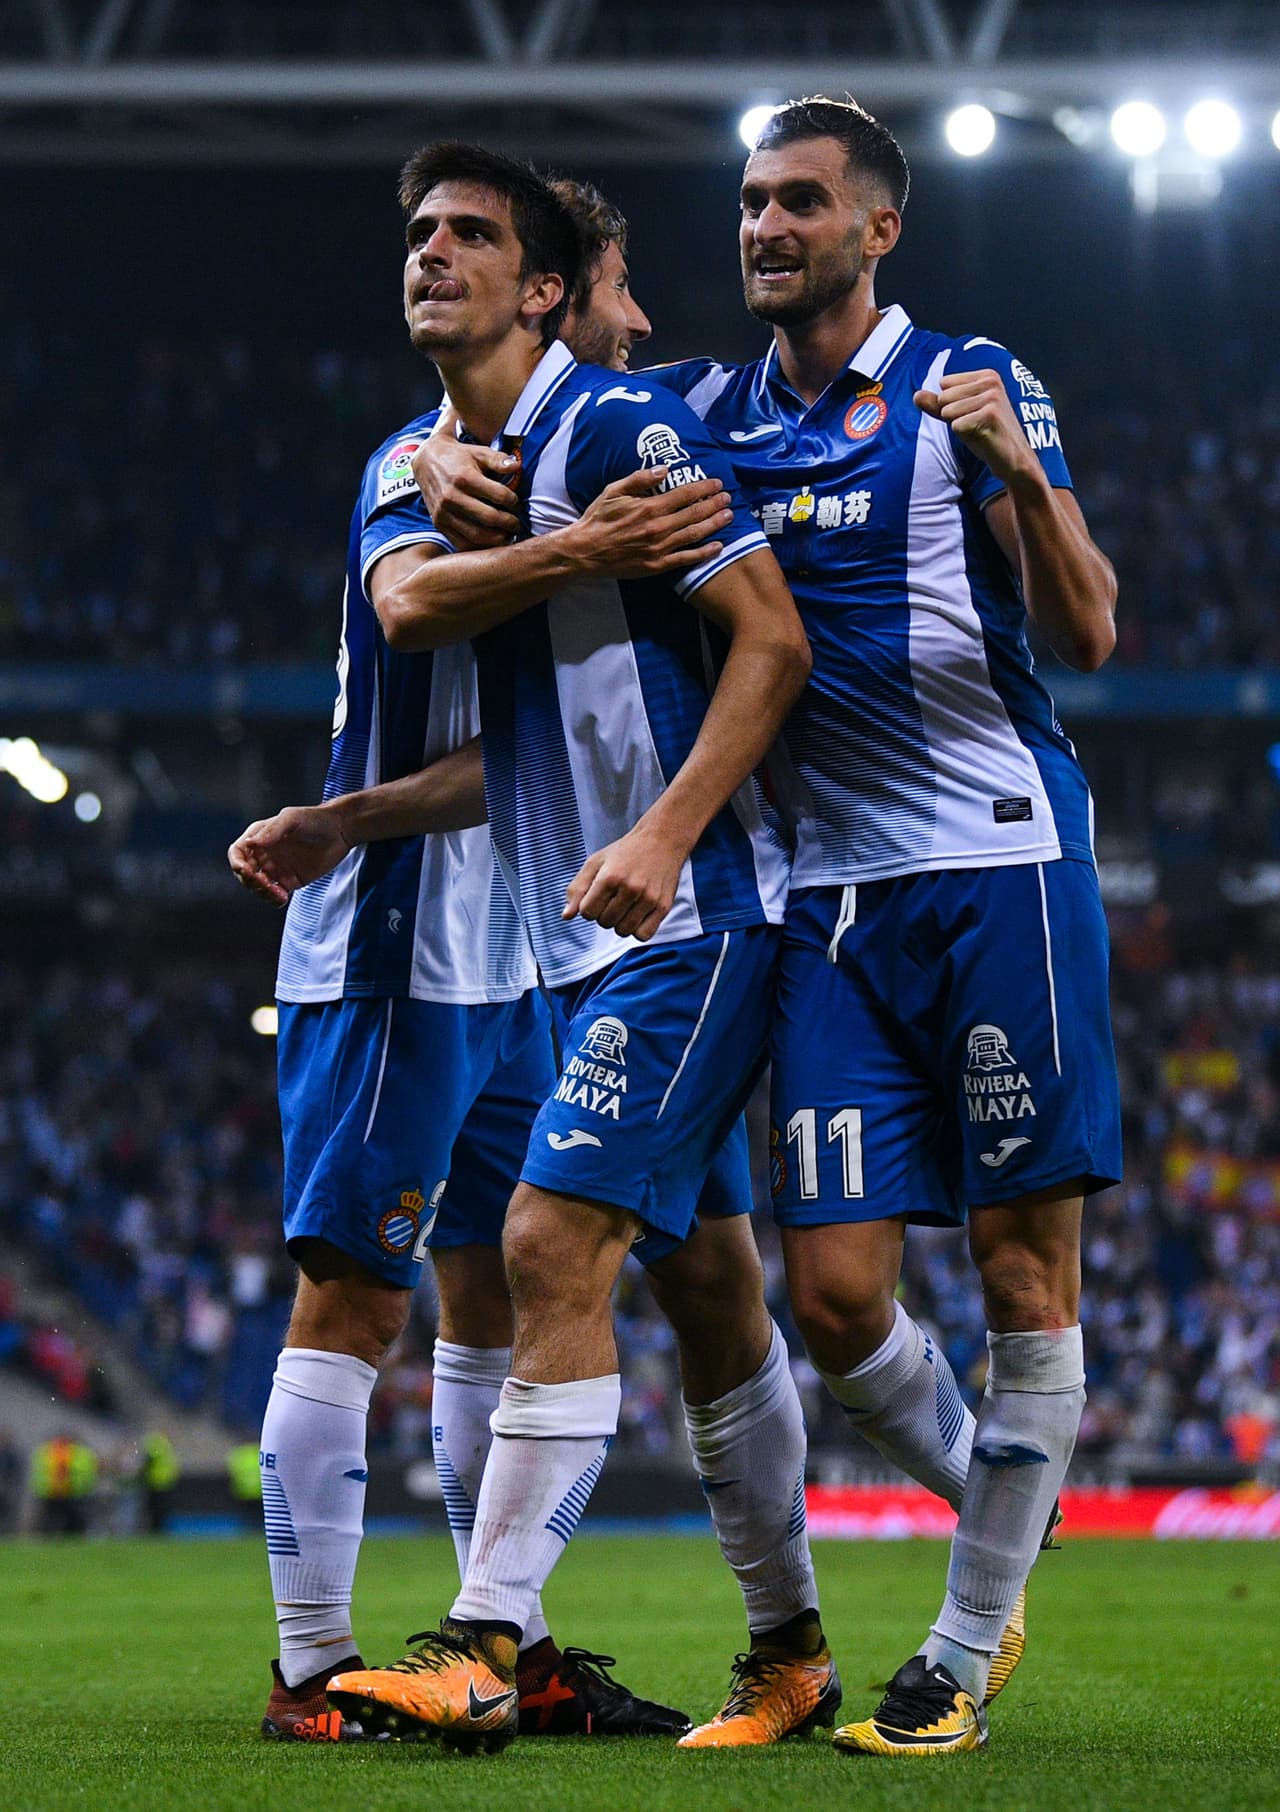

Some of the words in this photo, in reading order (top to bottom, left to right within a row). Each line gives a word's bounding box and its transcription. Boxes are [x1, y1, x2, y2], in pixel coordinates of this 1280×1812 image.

[1024, 421, 1063, 453] MA
[382, 478, 415, 496] LaLig
[658, 464, 708, 493] VIERA
[565, 1056, 627, 1093] RIVIERA
[963, 1072, 1032, 1094] RIVIERA
[553, 1075, 620, 1120] MAYA
[966, 1093, 1037, 1123] MAYA
[787, 1108, 864, 1199] 11
